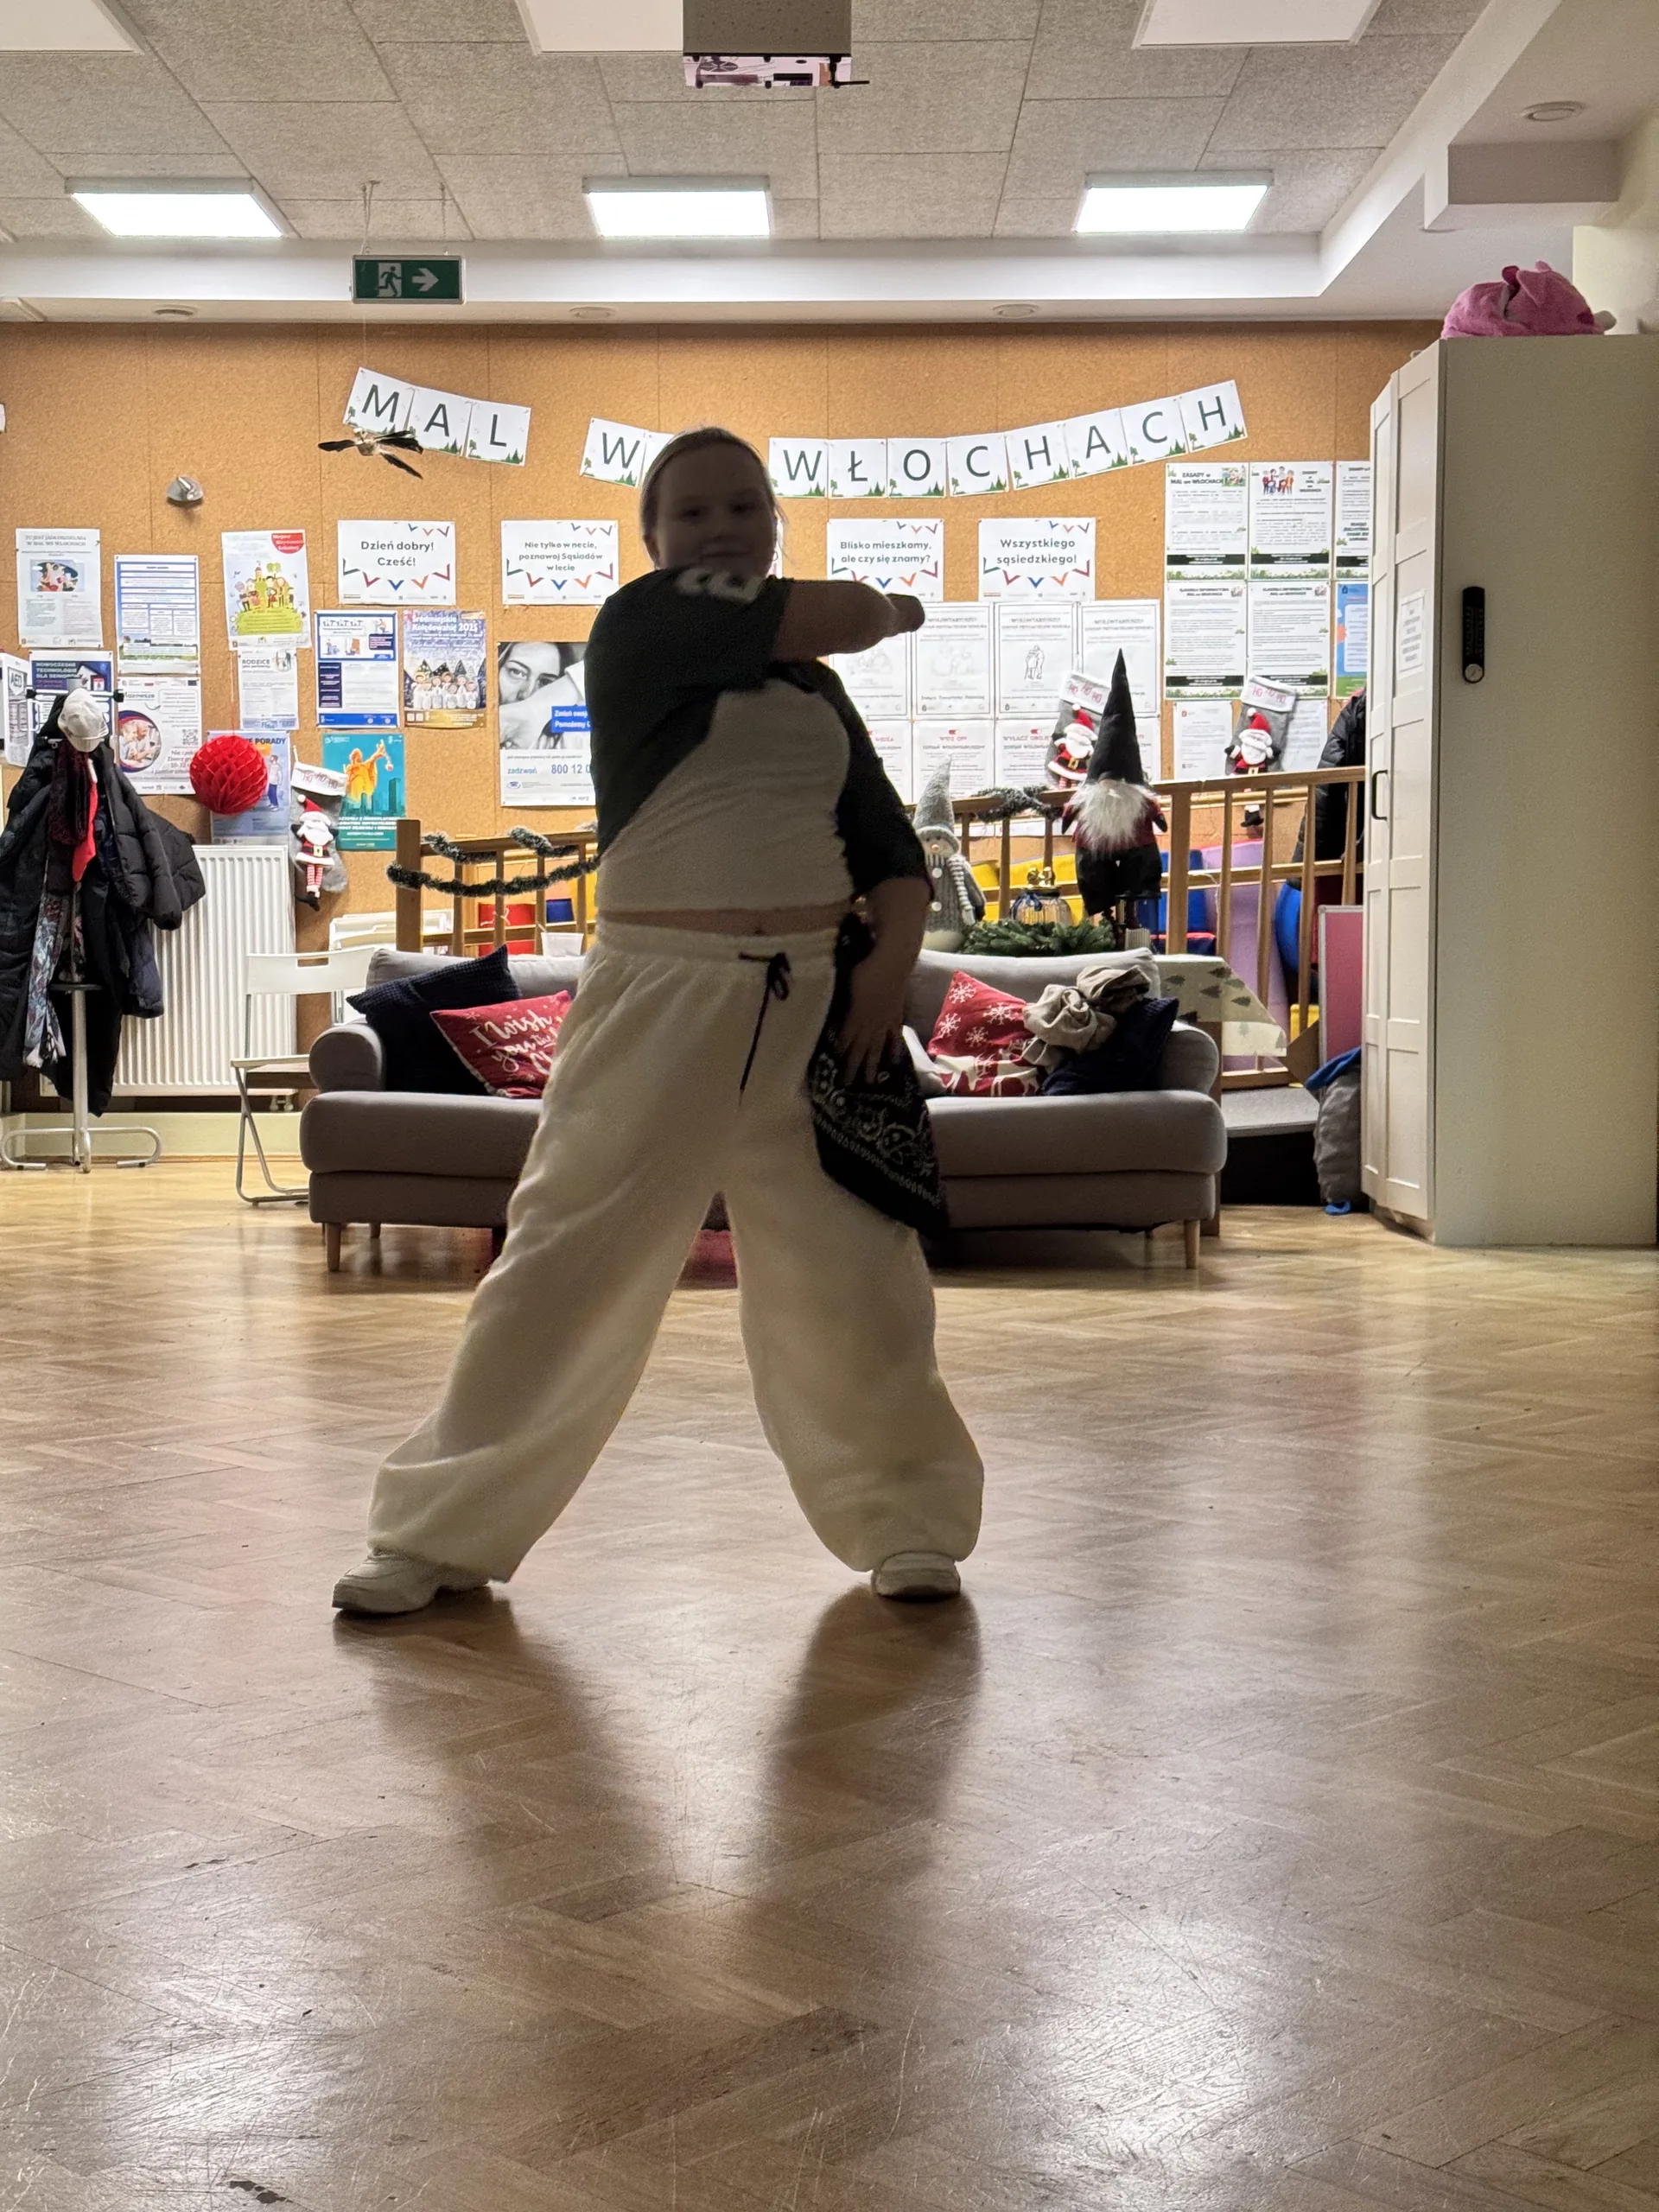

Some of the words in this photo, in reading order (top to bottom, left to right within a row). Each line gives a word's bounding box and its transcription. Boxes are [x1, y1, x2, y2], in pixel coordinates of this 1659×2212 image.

[361, 385, 507, 447] MAL
[783, 395, 1226, 483] WŁOCHACH
[360, 540, 394, 550] Dzień
[397, 541, 434, 553] dobry!
[873, 541, 931, 550] mieszkamy,
[1000, 537, 1075, 550] Wszystkiego
[377, 556, 416, 566] Cześć!
[858, 556, 874, 564] czy
[876, 555, 890, 564] się
[892, 555, 931, 563] znamy?
[996, 554, 1077, 566] sąsiedzkiego!
[458, 623, 478, 632] 2025
[551, 765, 569, 774] 800
[571, 765, 582, 773] 12
[469, 1026, 497, 1048] I
[491, 1040, 537, 1072] you
